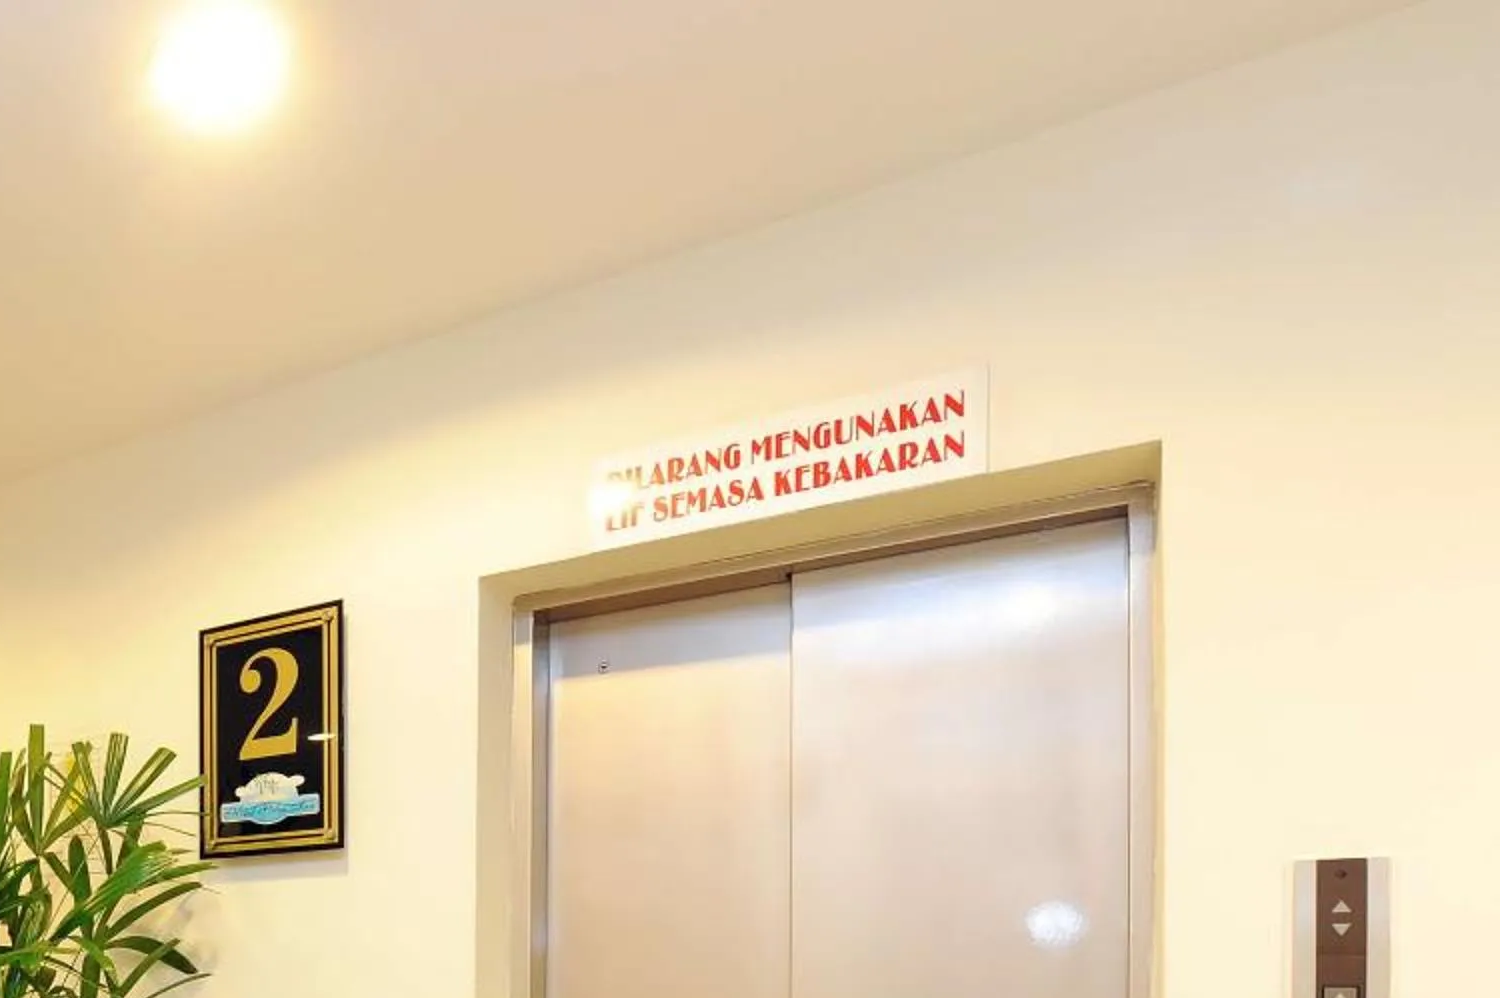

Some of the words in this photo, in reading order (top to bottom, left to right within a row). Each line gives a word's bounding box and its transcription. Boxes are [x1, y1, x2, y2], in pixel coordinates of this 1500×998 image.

[751, 389, 966, 465] MENGUNAKAN
[653, 476, 765, 523] SEMASA
[774, 430, 966, 498] KEBAKARAN
[239, 647, 300, 761] 2
